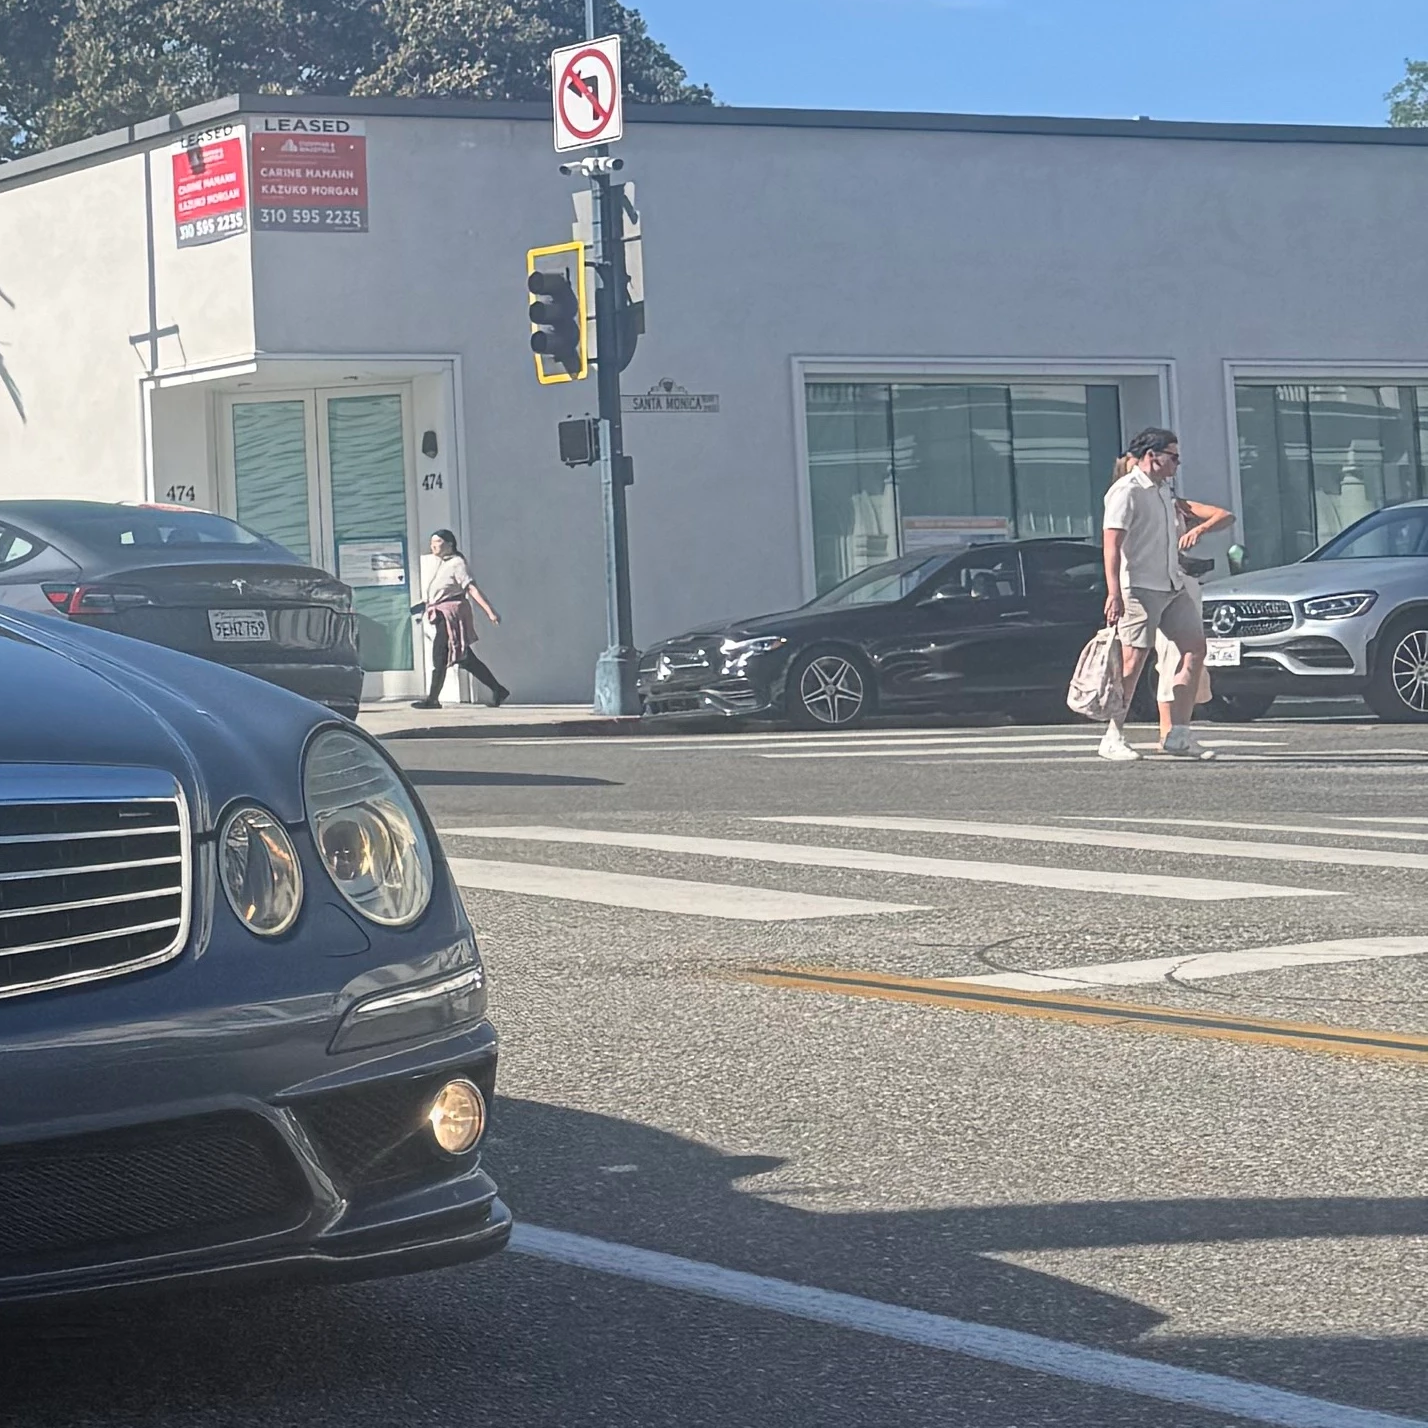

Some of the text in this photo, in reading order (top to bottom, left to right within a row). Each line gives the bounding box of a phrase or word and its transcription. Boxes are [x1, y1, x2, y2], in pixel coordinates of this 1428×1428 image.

[265, 119, 350, 133] LEASED
[181, 124, 233, 149] LEASED
[260, 168, 302, 178] CARINE
[261, 185, 307, 195] KAZUKO
[196, 218, 215, 236] 595
[217, 212, 243, 231] 2235
[260, 209, 361, 224] 310 595 2235
[632, 397, 663, 410] SANTA
[666, 397, 702, 410] MONICA
[422, 473, 443, 491] 474
[166, 485, 195, 502] 474
